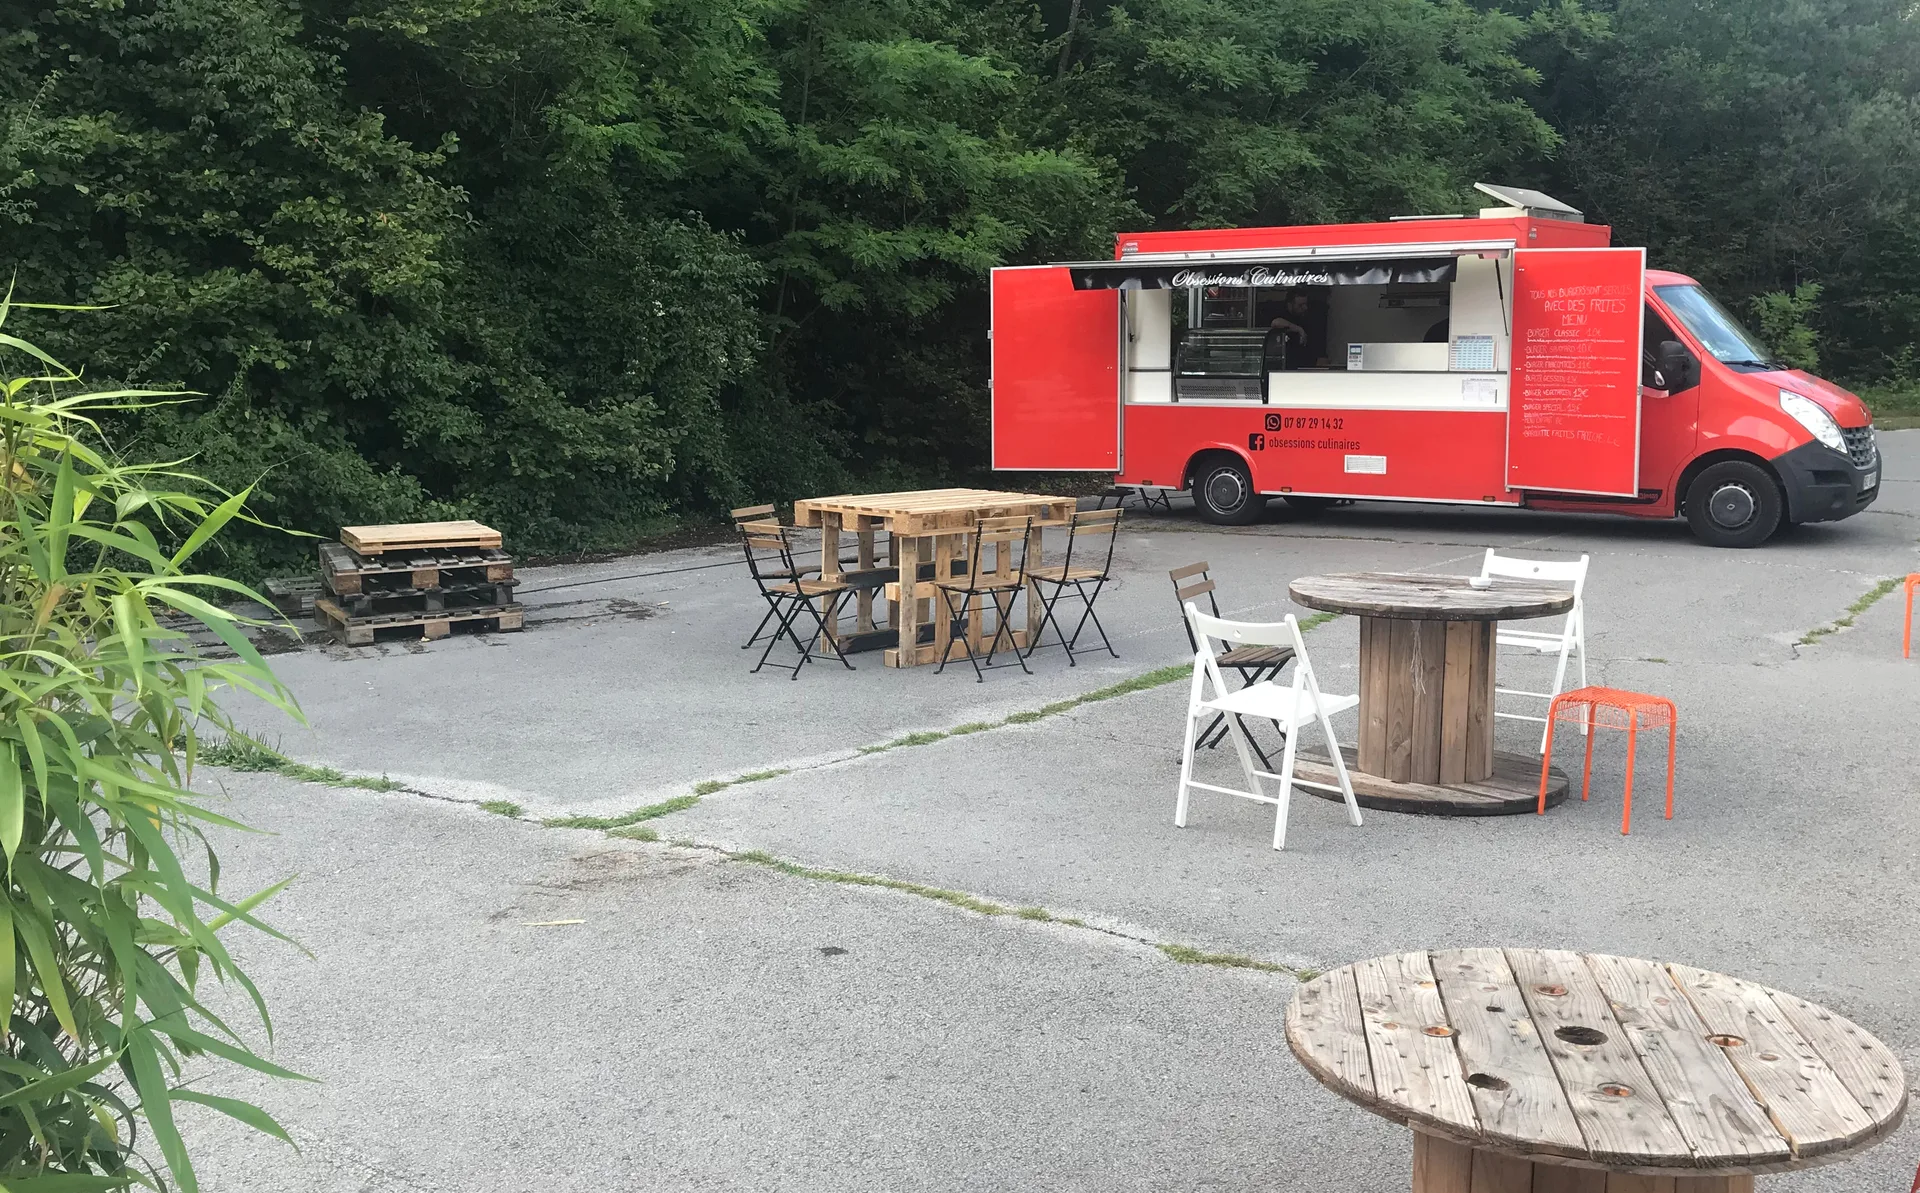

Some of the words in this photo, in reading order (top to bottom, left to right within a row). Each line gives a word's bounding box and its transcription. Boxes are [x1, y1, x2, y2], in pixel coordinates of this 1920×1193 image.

[1172, 268, 1244, 287] Obsessions
[1249, 265, 1328, 286] Culinaires
[1530, 289, 1546, 299] TOUS
[1544, 300, 1565, 312] AVEC
[1567, 298, 1586, 312] DES
[1589, 298, 1626, 313] FRITES
[1562, 314, 1588, 326] MENU
[1554, 329, 1581, 337] CLASSIC
[1284, 417, 1294, 429] 07
[1296, 417, 1307, 429] 87
[1309, 417, 1319, 429] 29
[1321, 418, 1331, 429] 14
[1333, 418, 1344, 430] 32
[1551, 430, 1575, 439] FRITES
[1269, 436, 1316, 448] obsessions
[1317, 437, 1361, 450] culinaires
